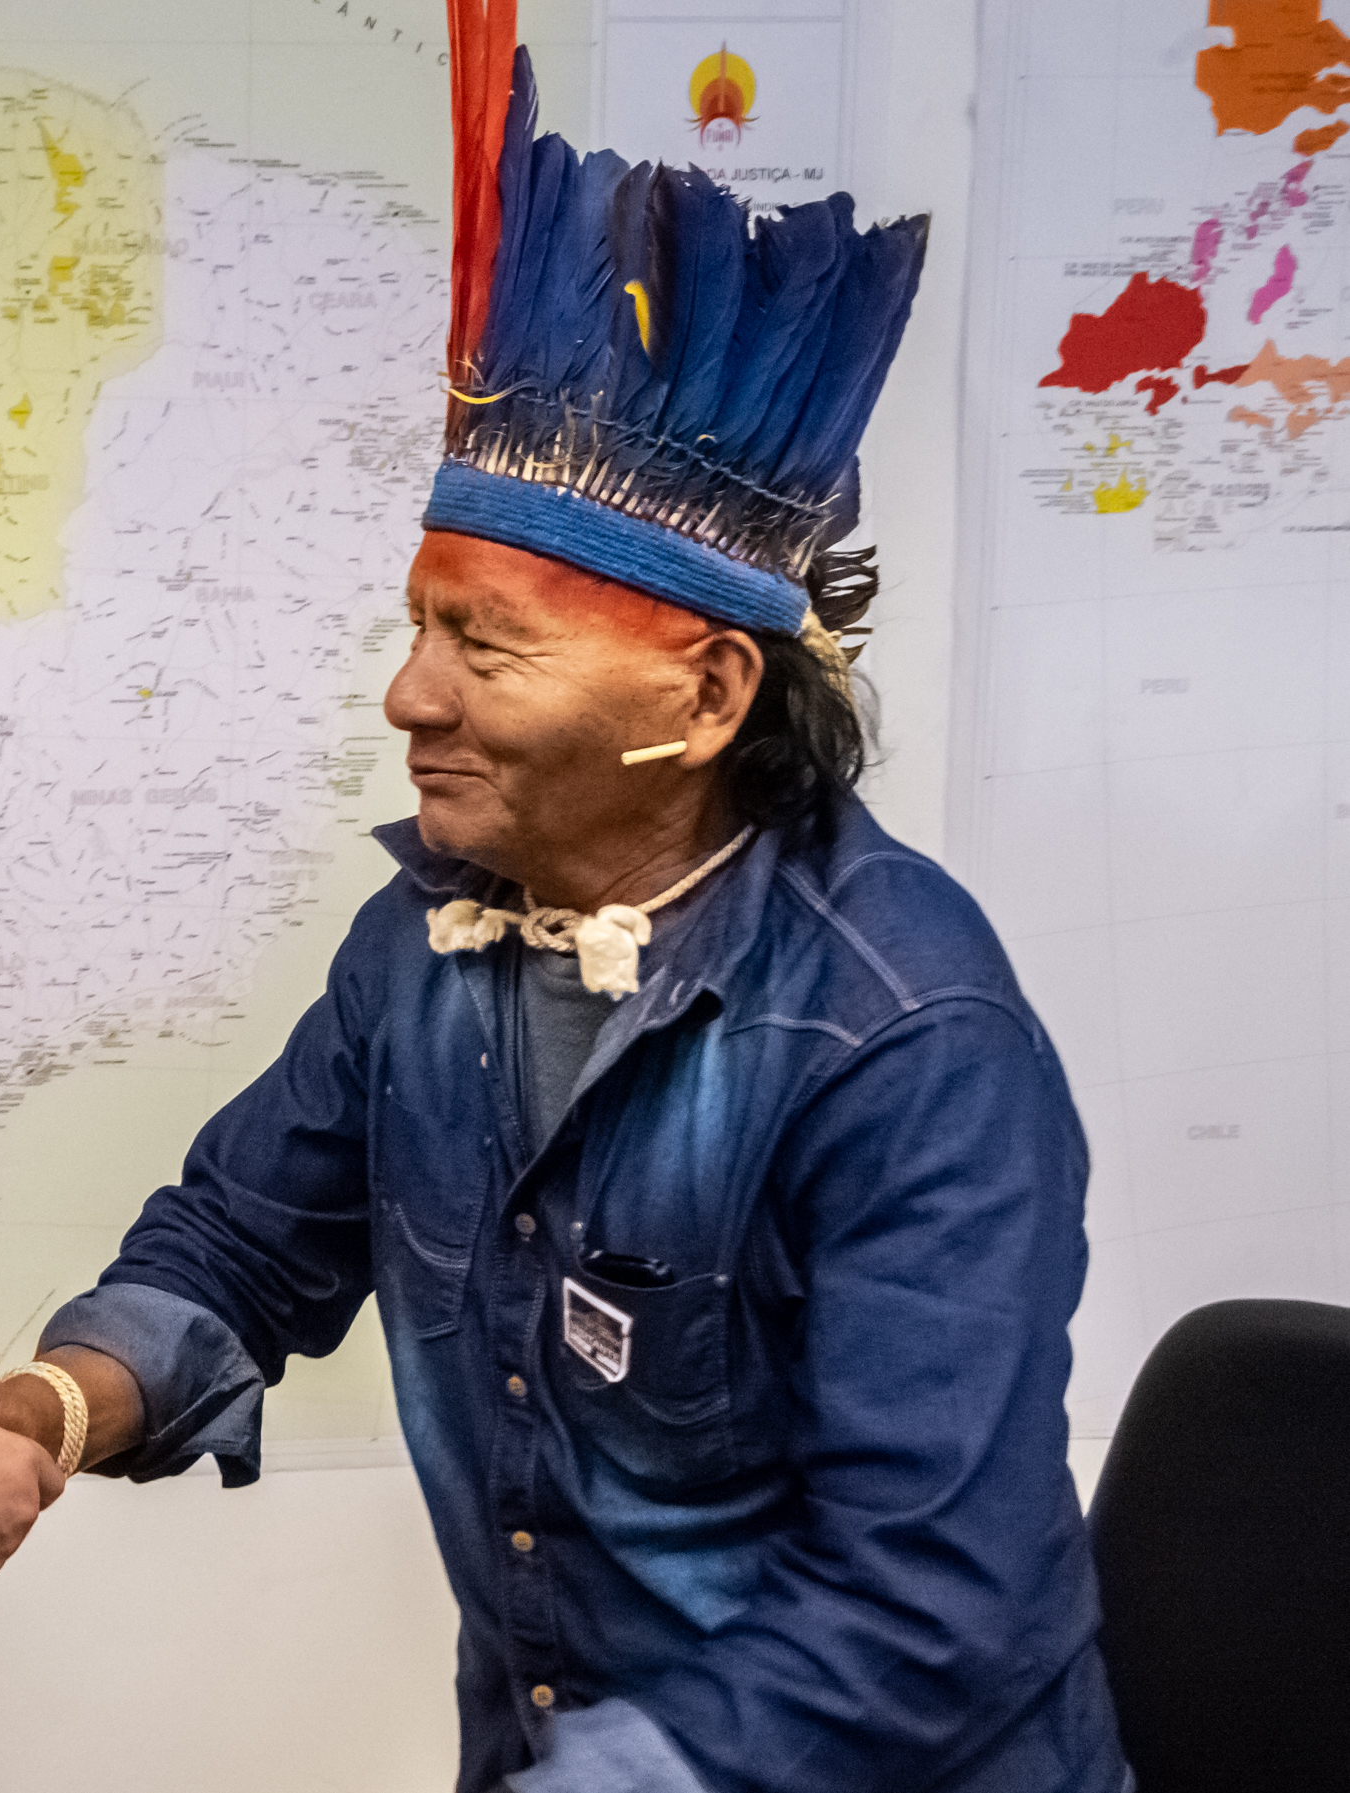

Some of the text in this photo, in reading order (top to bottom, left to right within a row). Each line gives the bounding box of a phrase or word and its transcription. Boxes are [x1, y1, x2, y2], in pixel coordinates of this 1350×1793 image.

[731, 167, 791, 183] JUSTIÇA
[804, 167, 823, 180] MJ
[195, 586, 256, 604] BAHIA
